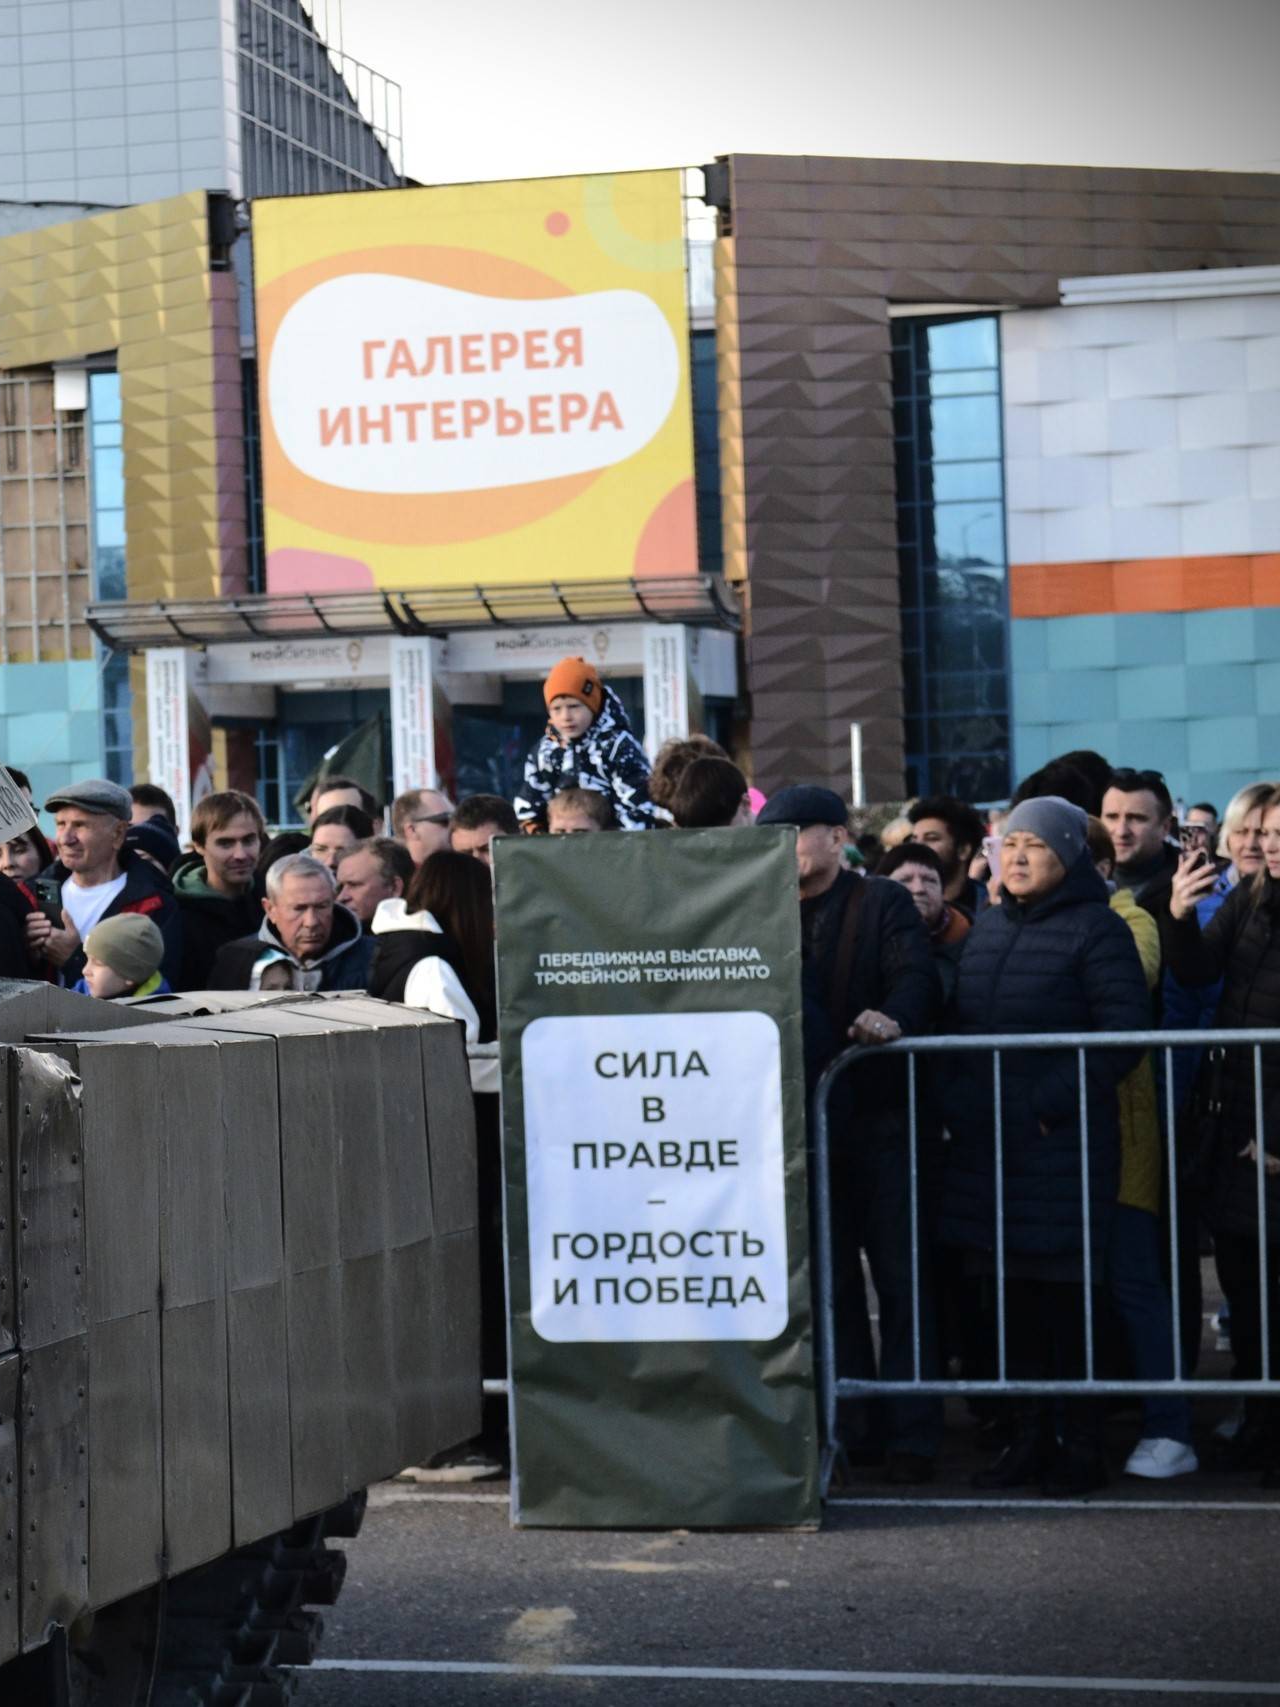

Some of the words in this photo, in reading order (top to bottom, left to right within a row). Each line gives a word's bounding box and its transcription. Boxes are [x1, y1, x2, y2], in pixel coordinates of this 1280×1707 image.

[361, 327, 585, 381] ГАЛЕРЕЯ
[318, 391, 625, 448] ИНТЕРЬЕРА
[539, 950, 667, 968] ПЕРЕДВИЖНАЯ
[669, 946, 762, 963] ВЫСТАВКА
[534, 967, 641, 986] ТРОФЕЙНОЙ
[643, 966, 721, 983] ТЕХНИКИ
[724, 964, 771, 981] НАТО
[594, 1050, 710, 1079] СИЛА
[641, 1096, 666, 1123] В
[572, 1140, 740, 1172] ПРАВДЕ
[552, 1231, 765, 1264] ГОРДОСТЬ
[553, 1278, 578, 1305] И
[594, 1276, 766, 1308] ПОБЕДА
